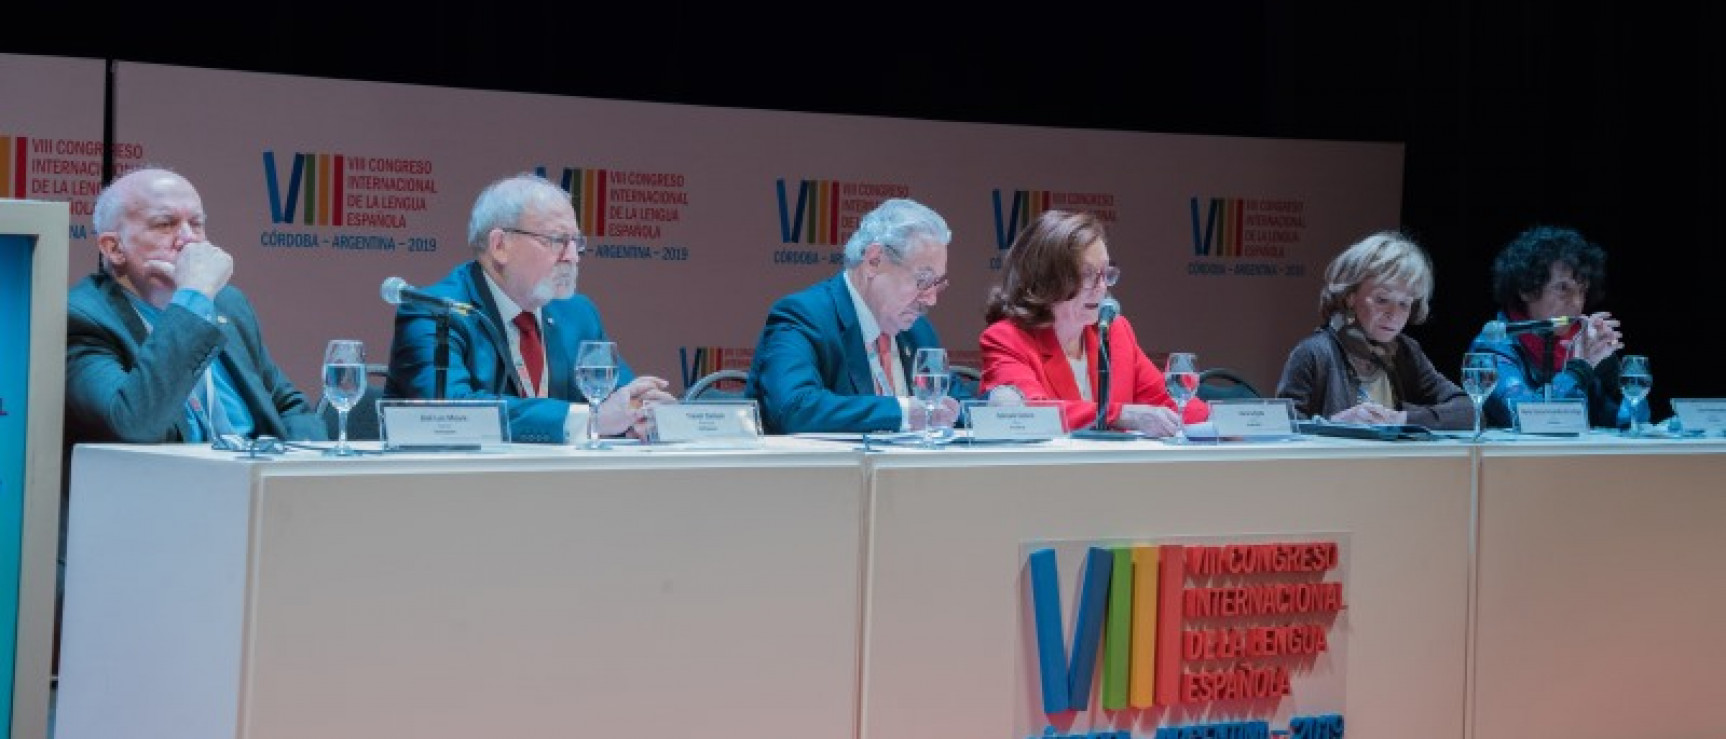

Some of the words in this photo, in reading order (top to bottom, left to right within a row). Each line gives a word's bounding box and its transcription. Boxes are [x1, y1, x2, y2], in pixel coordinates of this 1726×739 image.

[32, 139, 52, 153] VIII
[347, 156, 366, 170] VIII
[369, 158, 432, 174] CONGRESO
[32, 178, 49, 193] DE
[53, 179, 68, 194] LA
[347, 176, 438, 193] INTERNACIONAL
[629, 172, 685, 187] CONGRESO
[347, 195, 363, 209] DE
[366, 195, 380, 210] LA
[381, 195, 427, 212] LENGUA
[610, 188, 689, 205] INTERNACIONAL
[347, 212, 407, 229] ESPAÑOLA
[610, 206, 623, 220] DE
[640, 207, 680, 222] LENGUA
[261, 230, 319, 248] CÓRDOBA
[332, 234, 396, 251] ARGENTINA
[408, 238, 437, 252] 2019
[595, 244, 651, 260] ARGENTINA
[662, 246, 689, 261] 2019
[1226, 542, 1339, 574] CONGRESO
[1245, 624, 1330, 658] LENGUA
[1182, 664, 1292, 703] ESPAÑOLA
